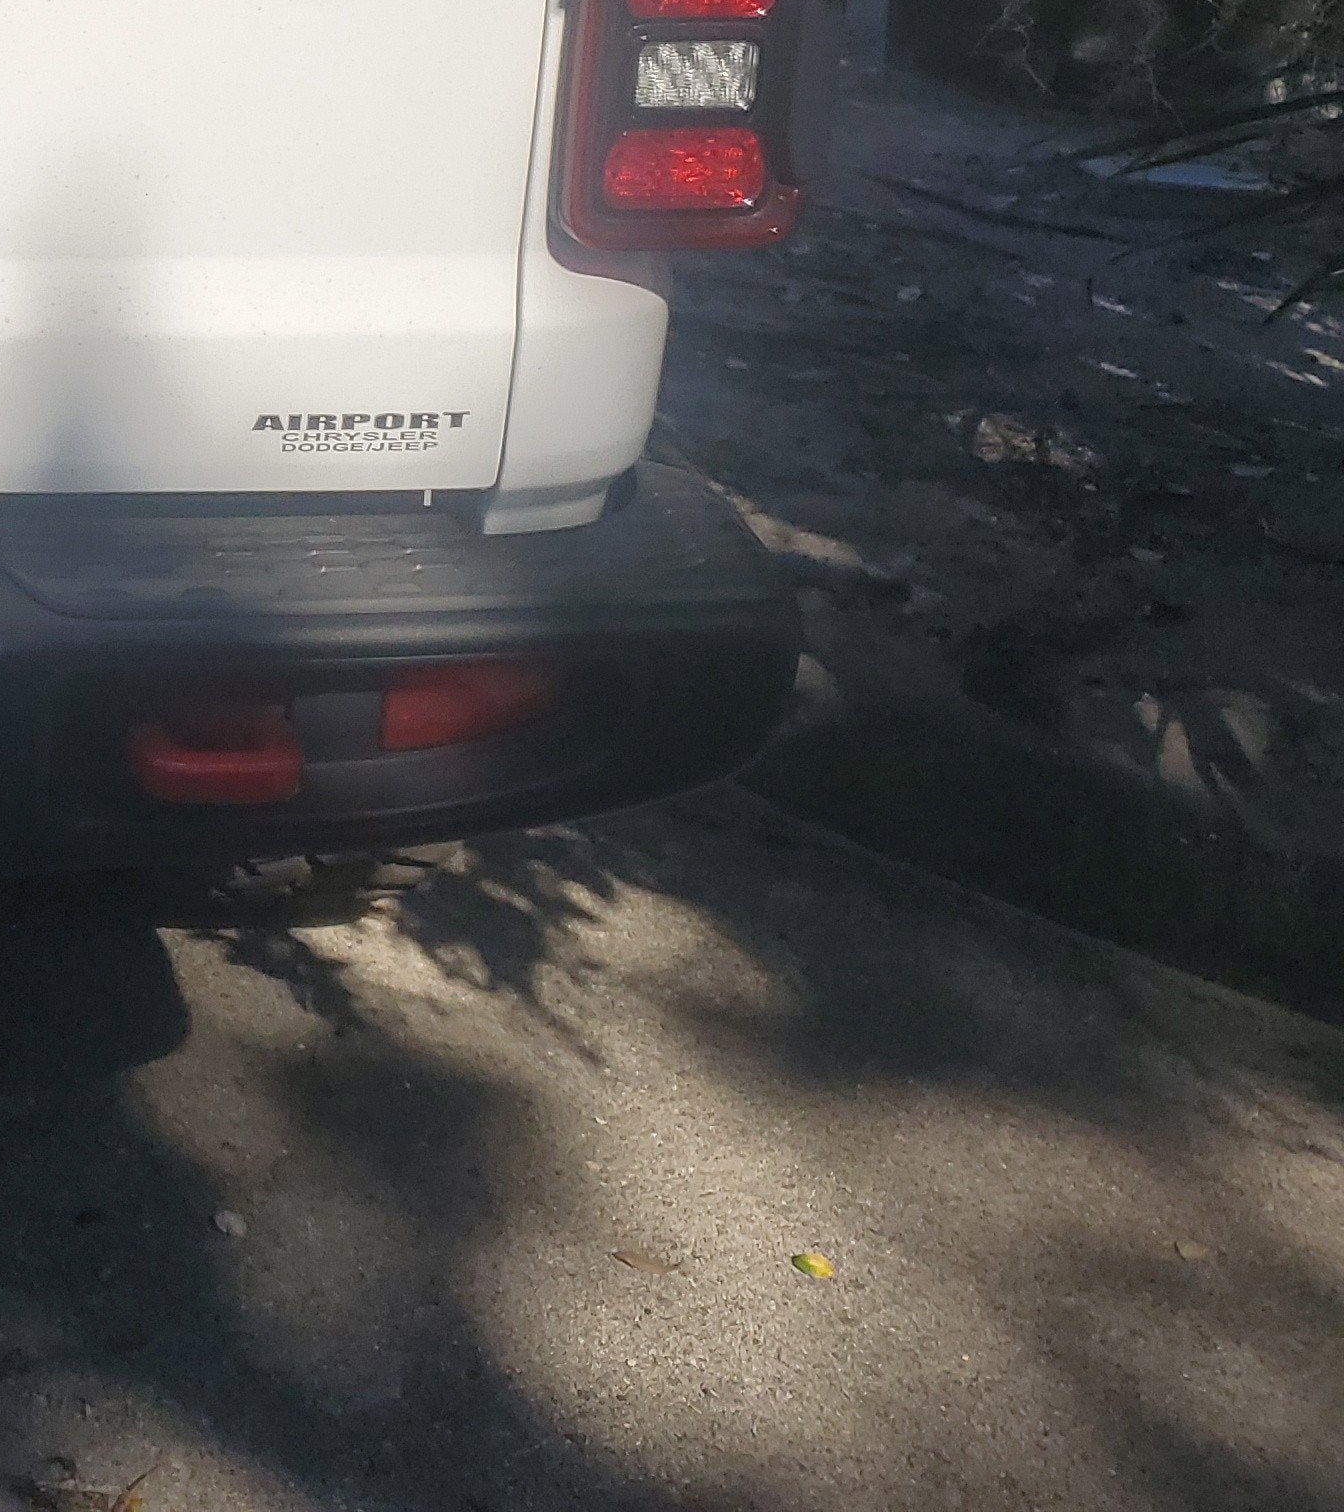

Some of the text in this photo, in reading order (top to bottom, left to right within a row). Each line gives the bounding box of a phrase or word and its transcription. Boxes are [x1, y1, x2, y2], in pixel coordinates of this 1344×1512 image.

[252, 411, 470, 431] AIRPORT
[281, 431, 437, 442] CHRYSLER
[281, 441, 438, 453] DODGE/JEEP
